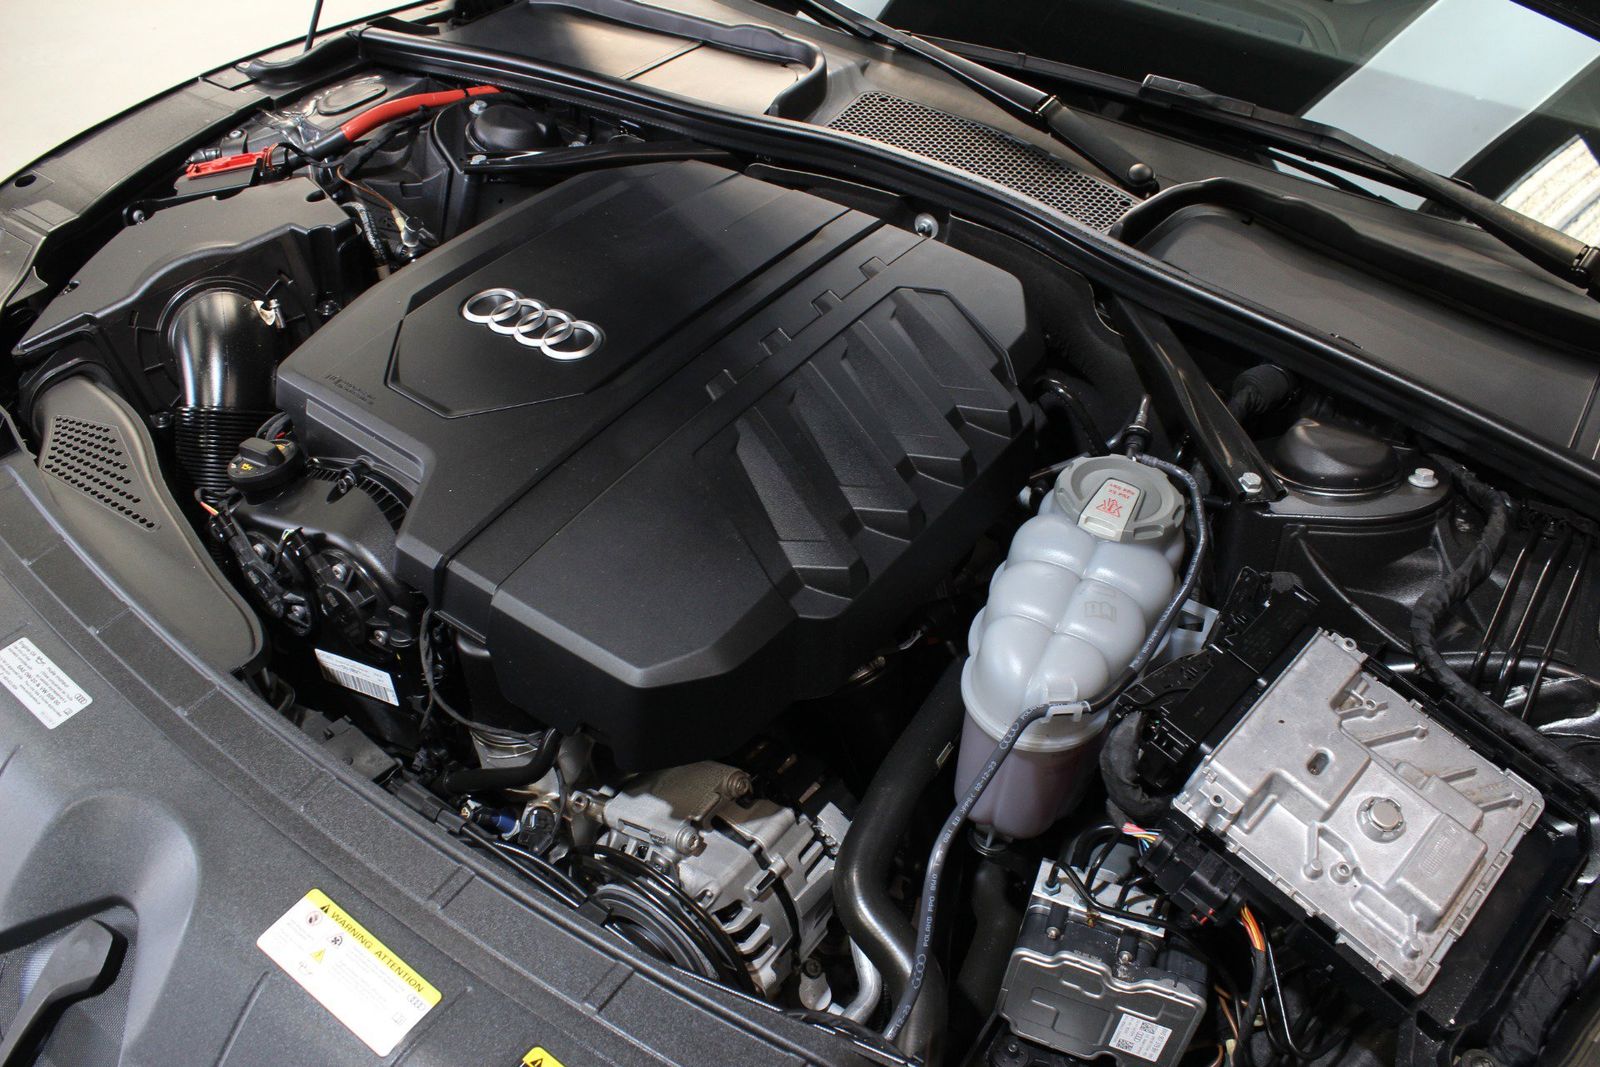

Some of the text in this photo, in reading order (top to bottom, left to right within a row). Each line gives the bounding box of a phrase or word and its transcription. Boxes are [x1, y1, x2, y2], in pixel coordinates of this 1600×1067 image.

[331, 911, 374, 950] WARNING
[374, 949, 424, 993] ATTENTION
[922, 916, 933, 947] POLAND
